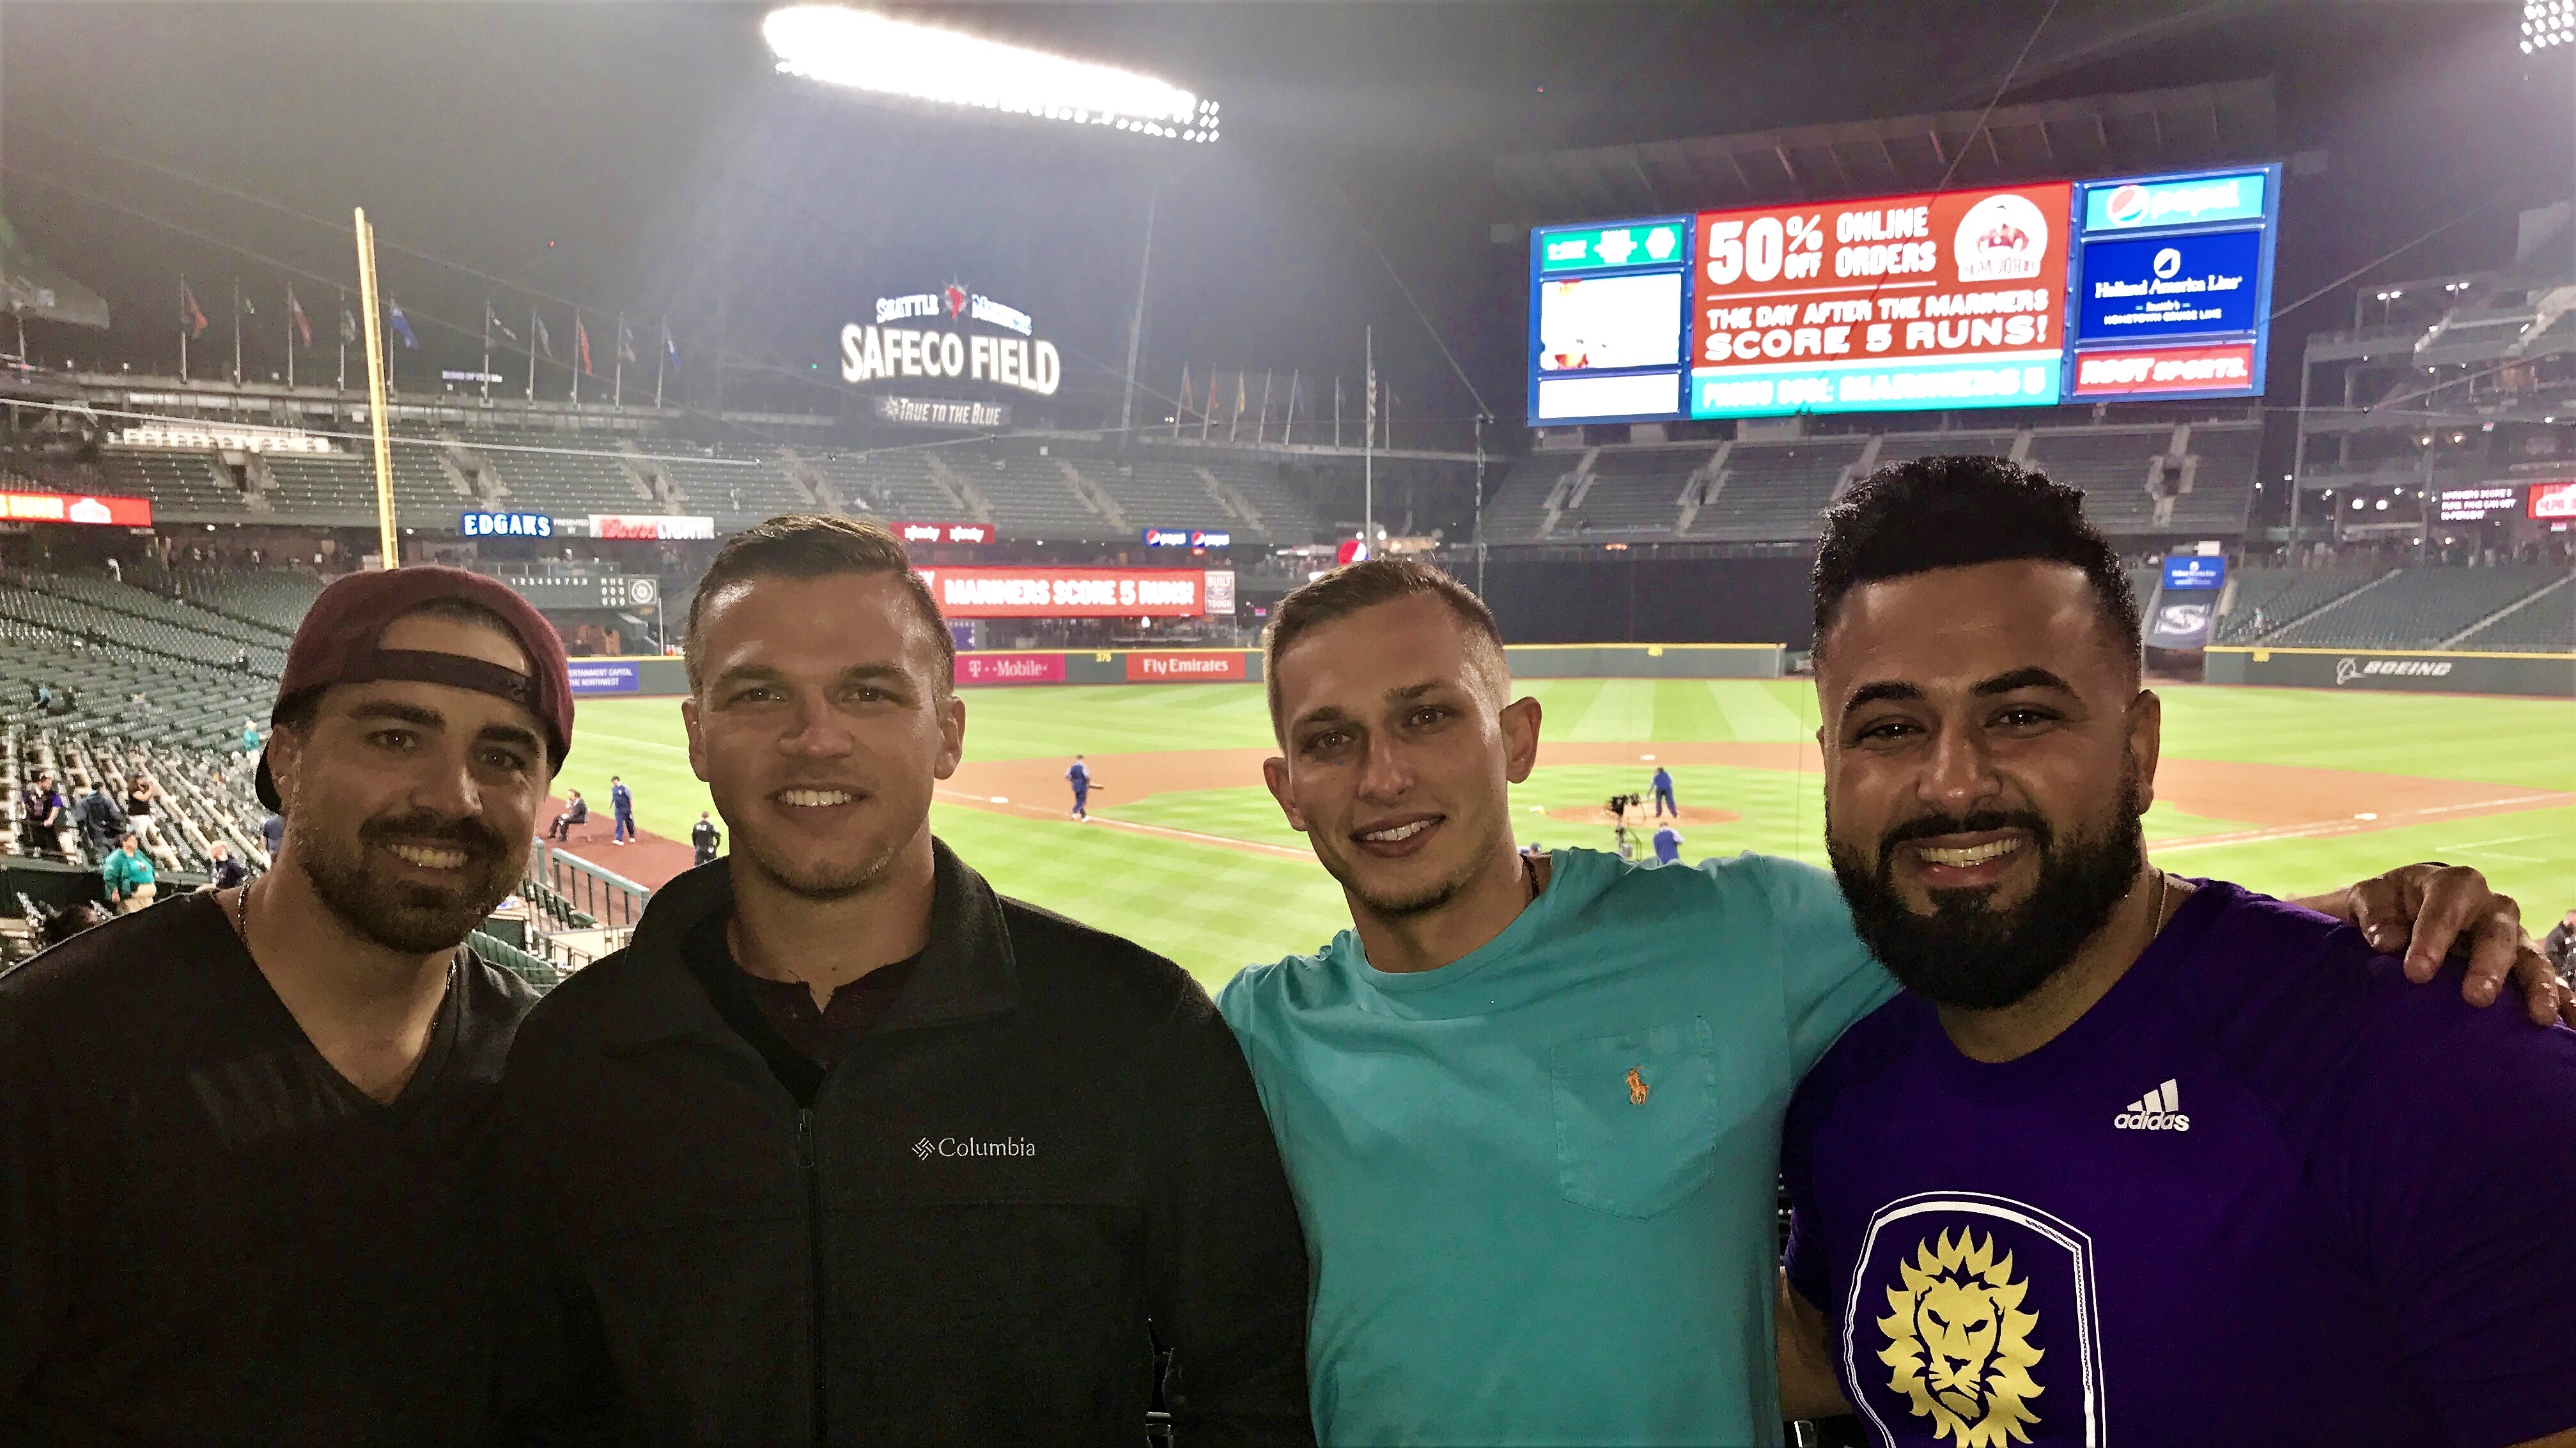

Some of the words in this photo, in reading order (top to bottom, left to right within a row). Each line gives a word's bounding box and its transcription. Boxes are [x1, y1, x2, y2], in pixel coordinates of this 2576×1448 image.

[1836, 206, 1928, 243] ONLINE
[1784, 252, 1822, 279] OFF
[1835, 241, 1937, 277] ORDERS
[2095, 279, 2148, 298] Holland
[2149, 277, 2205, 295] America
[876, 294, 940, 323] SEATTLE
[1706, 307, 1753, 330] THE
[1756, 304, 1798, 327] DAY
[1803, 300, 1872, 325] AFTER
[1877, 297, 1921, 320] THE
[1925, 289, 2049, 317] MARINERS
[1705, 326, 1851, 361] SCORE
[1866, 323, 1892, 352] 5
[1906, 314, 2048, 350] RUNS!
[841, 323, 963, 383] SAFECO
[970, 335, 1060, 395] FIELD
[900, 398, 931, 422] TRUE
[932, 404, 946, 422] TO
[949, 404, 970, 424] THE
[972, 403, 1002, 426] BLUE
[945, 579, 1050, 605] MARINERS
[1053, 580, 1117, 605] SCORE
[1120, 580, 1136, 605] 5
[1138, 580, 1194, 605] RUNS!
[568, 668, 607, 677] ERTAINMENT
[609, 668, 633, 677] CAPITAL
[1144, 659, 1167, 675] Fly
[1169, 659, 1229, 672] Emirates
[2363, 661, 2452, 675] BOEING
[2114, 1111, 2190, 1132] adidas
[938, 1137, 1035, 1157] Columbia
